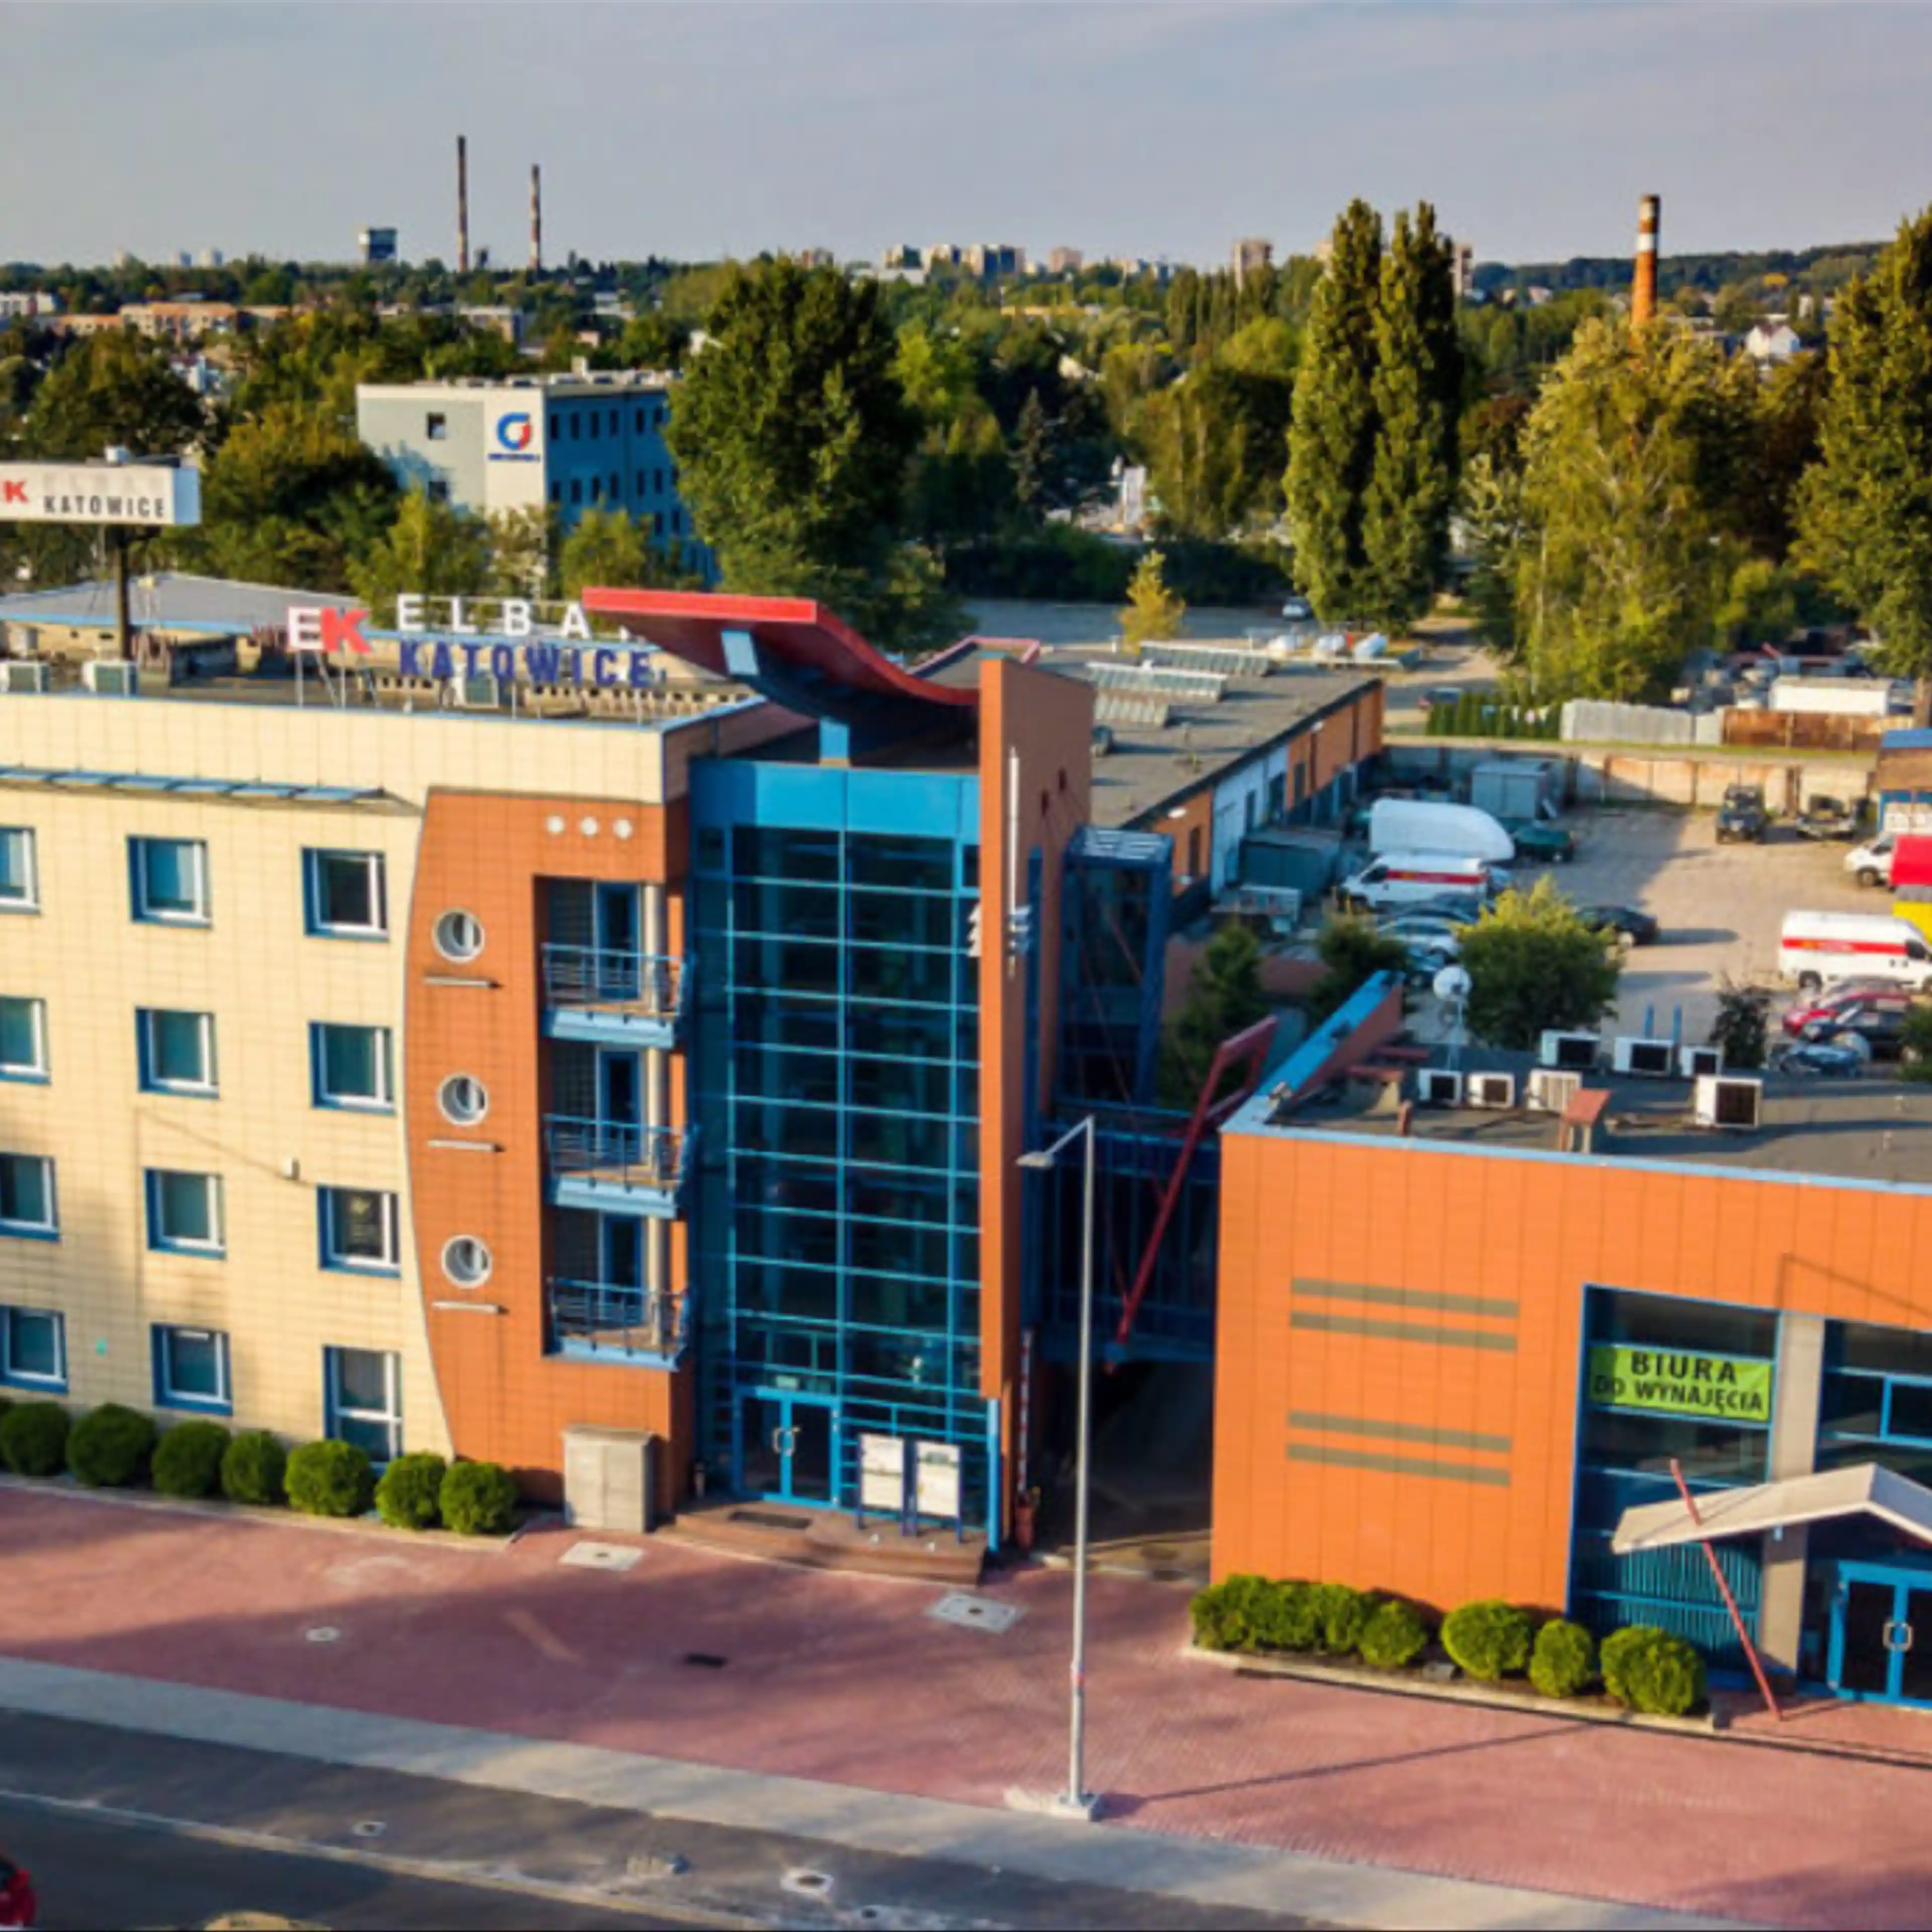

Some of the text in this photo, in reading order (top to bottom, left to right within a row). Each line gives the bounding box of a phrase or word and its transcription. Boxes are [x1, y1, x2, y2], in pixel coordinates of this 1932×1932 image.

[43, 495, 165, 518] KATOWICE
[288, 607, 371, 654] EK
[400, 639, 652, 687] KATOWICE
[1631, 1351, 1737, 1385] BIURA
[1593, 1375, 1764, 1414] DO WYNAJĘCIA
